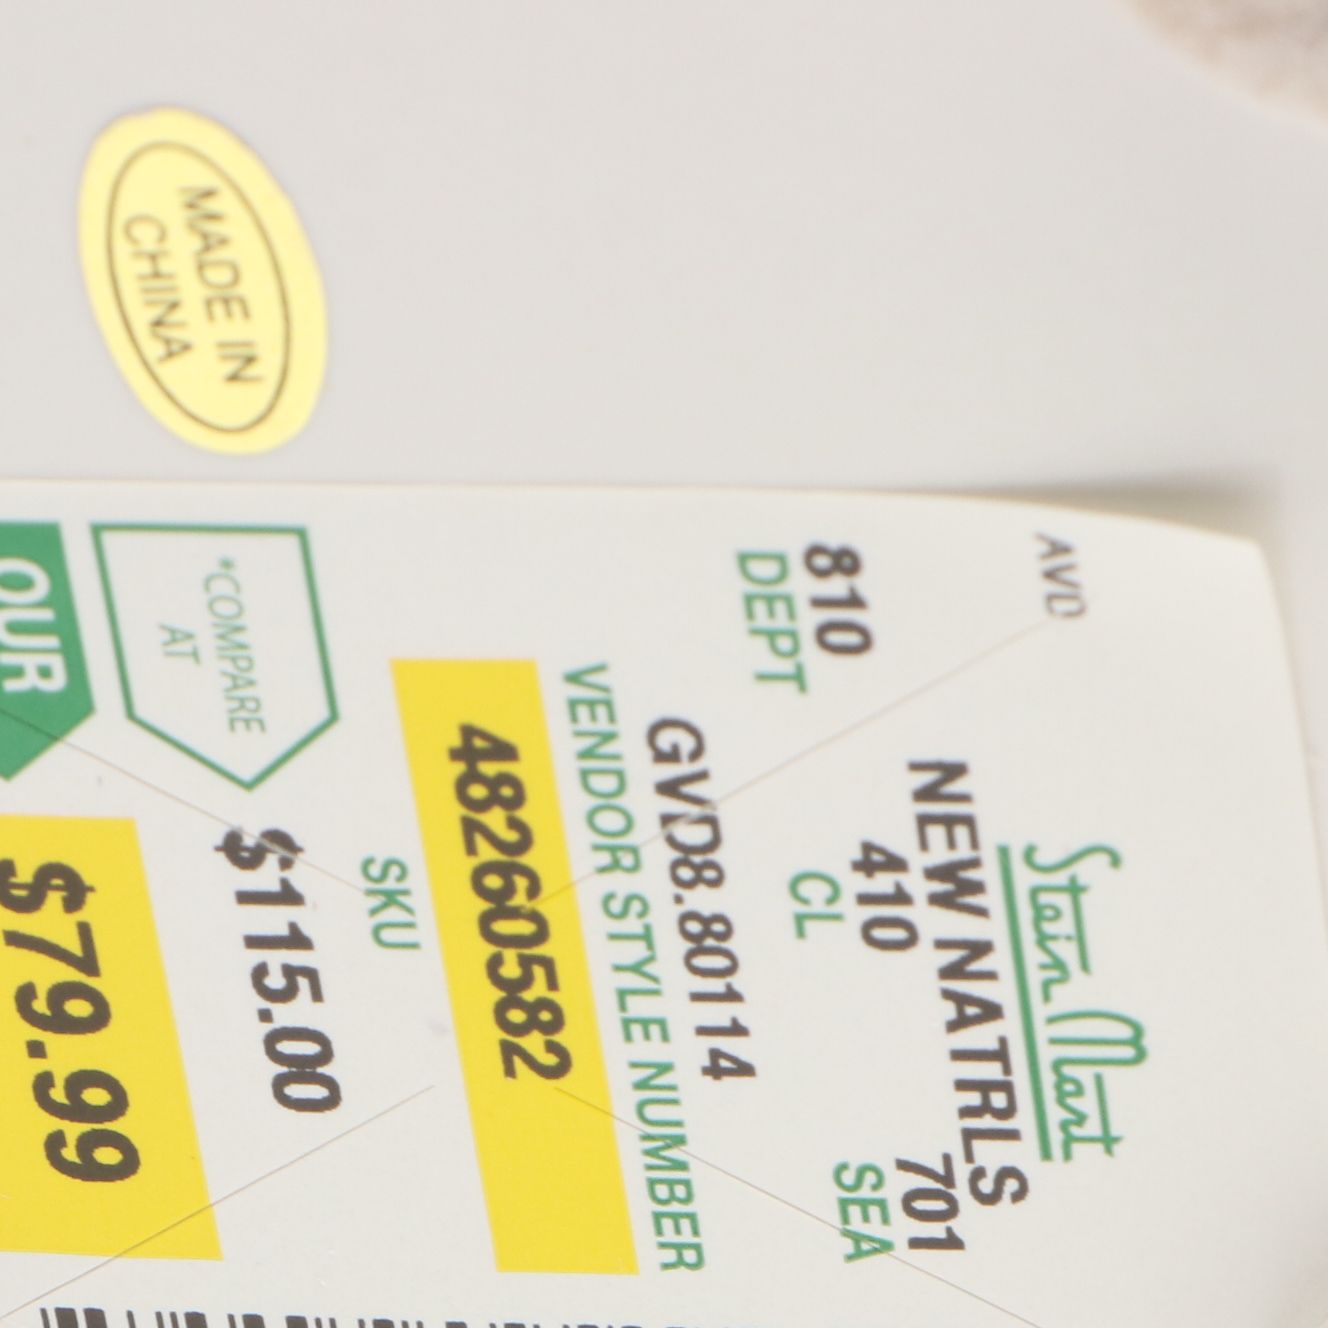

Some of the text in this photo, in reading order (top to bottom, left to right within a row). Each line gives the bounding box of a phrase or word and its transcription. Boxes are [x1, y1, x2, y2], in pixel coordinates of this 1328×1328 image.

[123, 214, 193, 364] CHINA
[178, 186, 265, 385] MADE IN
[159, 622, 200, 665] AT
[214, 828, 342, 1113] $115.00
[361, 856, 421, 951] SKU
[448, 723, 572, 1081] 48260582
[562, 662, 705, 1274] VENDOR STYLE NUMBER
[646, 718, 757, 1080] GVD8.80114
[735, 550, 895, 1264] DEPT CL SEA
[803, 542, 966, 1253] 810 410 701
[907, 759, 1030, 1208] NEW NATRLS
[1023, 843, 1147, 1164] Stein Mart
